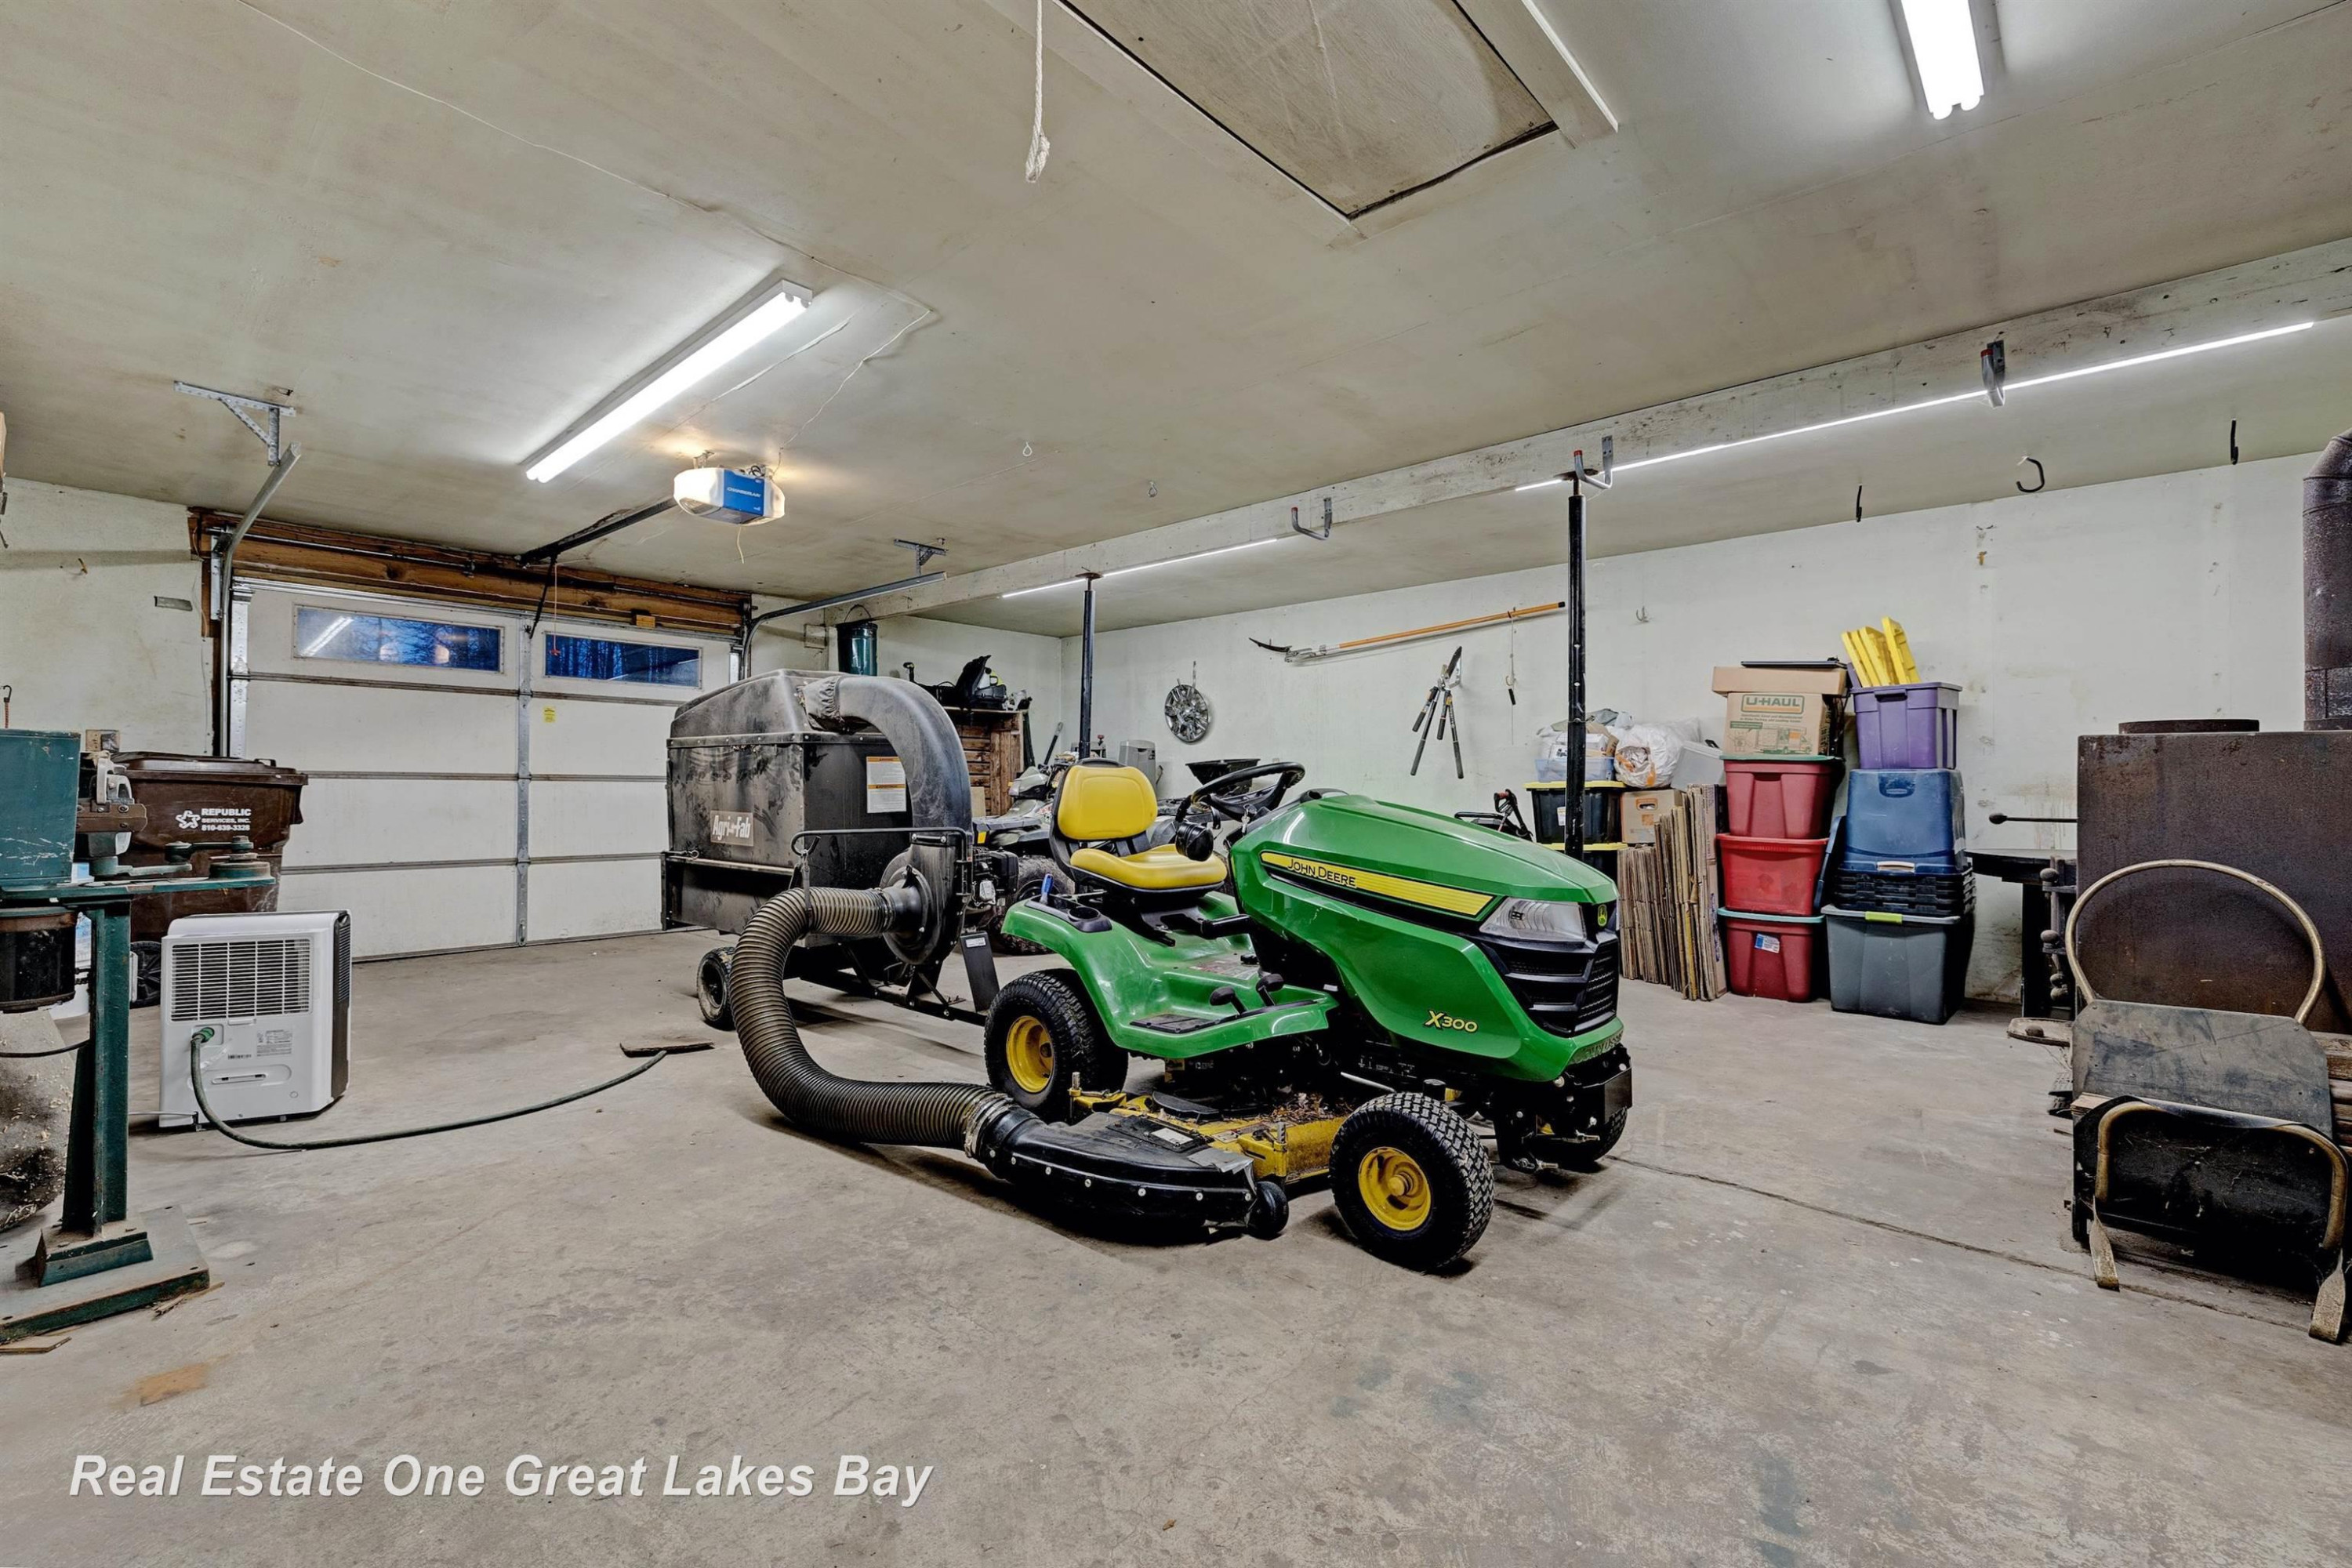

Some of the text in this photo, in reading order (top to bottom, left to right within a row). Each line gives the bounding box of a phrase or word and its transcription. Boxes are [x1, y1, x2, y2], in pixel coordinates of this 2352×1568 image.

[1745, 696, 1801, 707] U-HAUL
[201, 808, 252, 816] REPUBLIC
[712, 815, 751, 840] Agri-Fab
[1287, 858, 1357, 888] JOHN DEERE
[1424, 1009, 1479, 1033] X300
